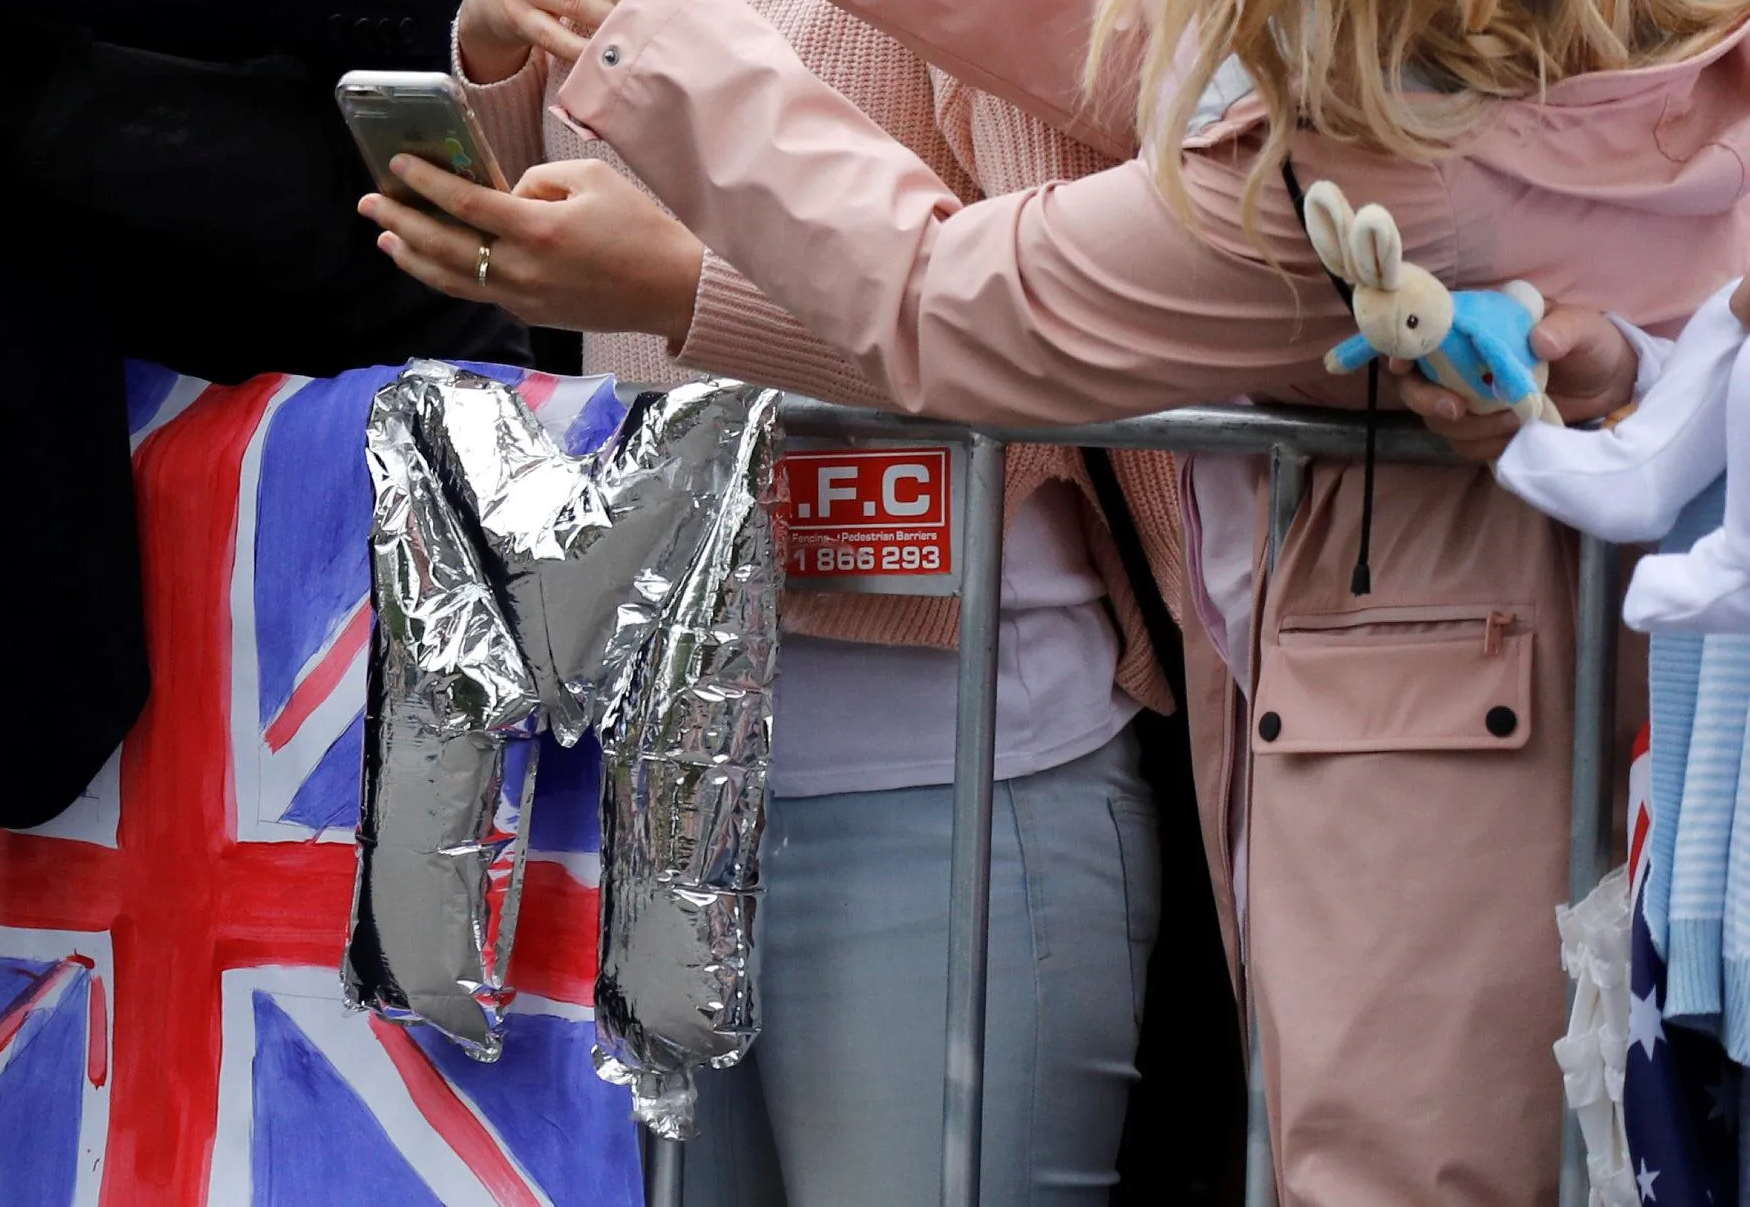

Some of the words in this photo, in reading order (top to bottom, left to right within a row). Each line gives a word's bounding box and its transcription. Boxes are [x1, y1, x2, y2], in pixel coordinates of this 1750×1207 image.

[841, 531, 895, 542] Pedestrian
[896, 530, 938, 541] Barriers
[817, 546, 875, 571] 866
[881, 545, 940, 570] 293
